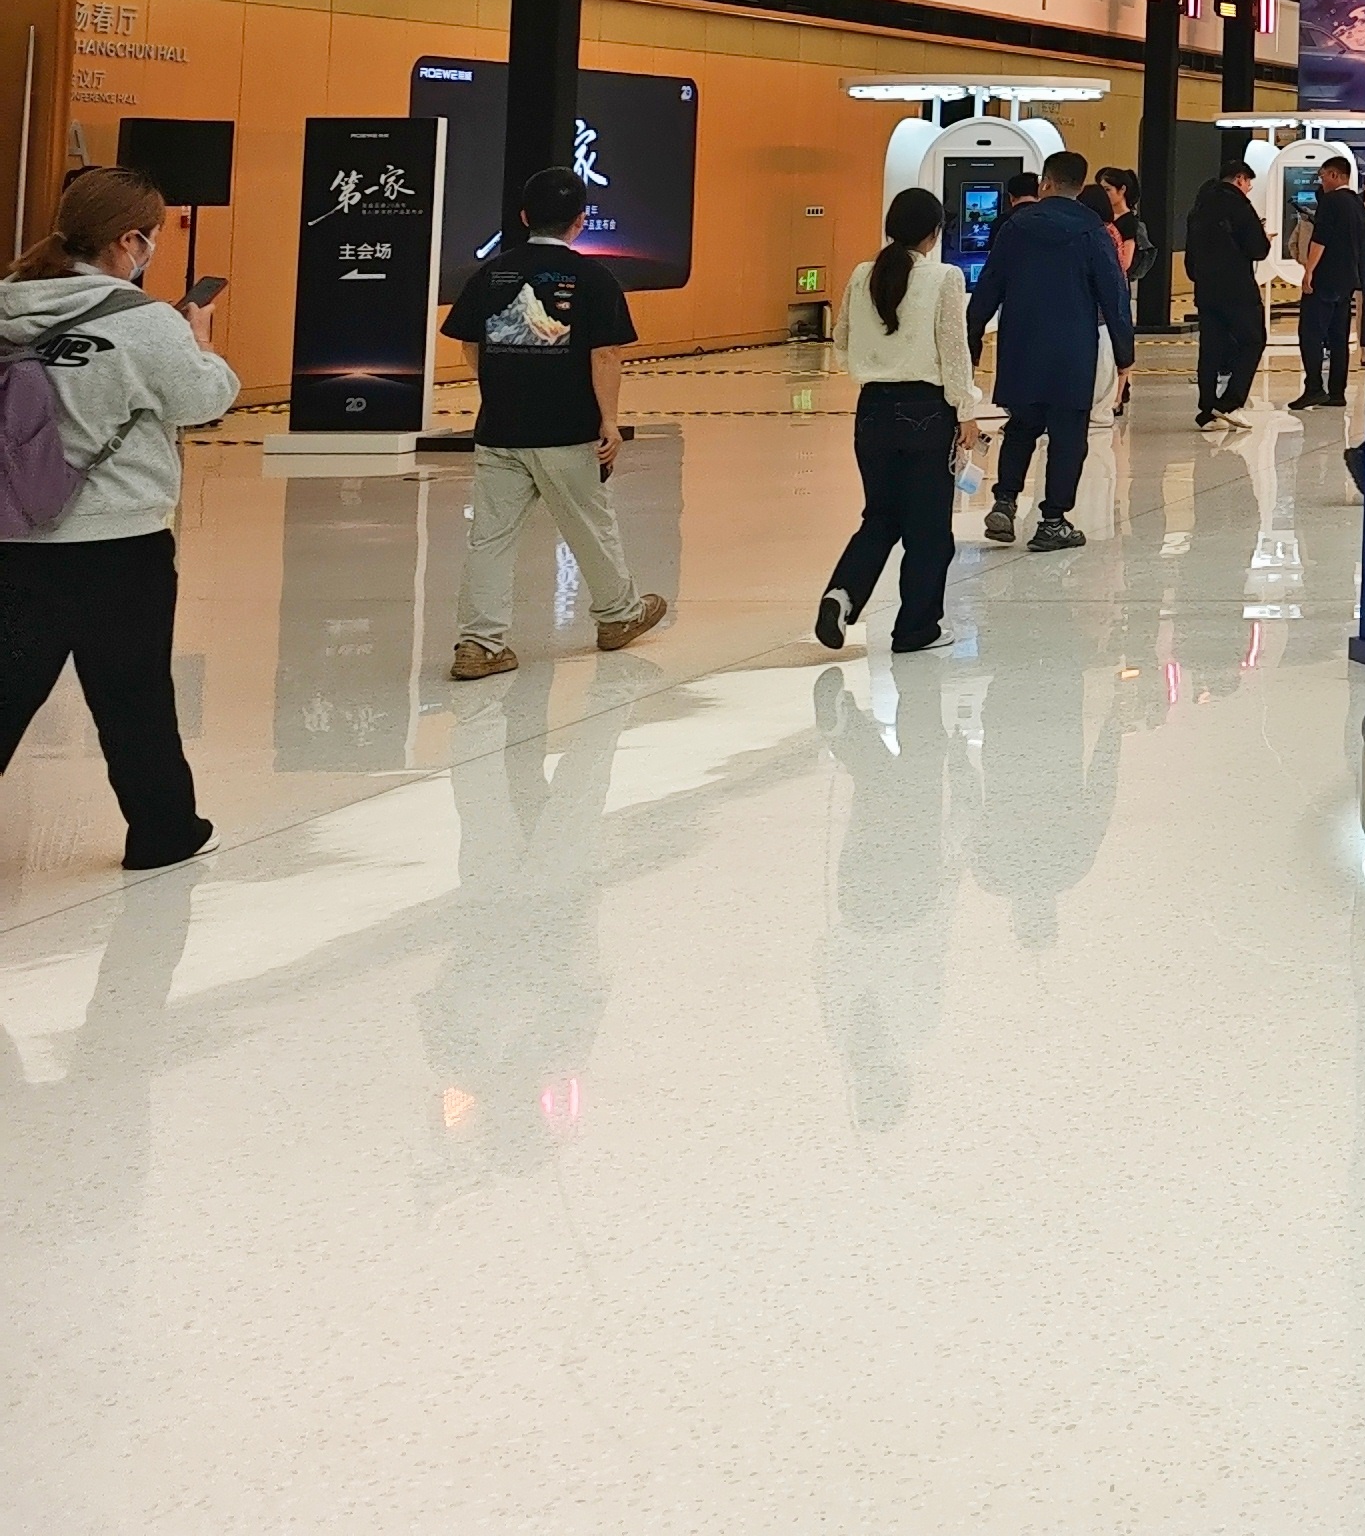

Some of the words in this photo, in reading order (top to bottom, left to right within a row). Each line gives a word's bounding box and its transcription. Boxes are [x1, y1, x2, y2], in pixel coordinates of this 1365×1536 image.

[75, 38, 154, 61] HANGCHUN
[157, 45, 190, 64] HALL
[420, 67, 459, 80] ROEWE
[67, 119, 91, 167] A
[308, 164, 416, 226] 第一家
[338, 243, 392, 260] 主会场
[345, 397, 367, 412] 20
